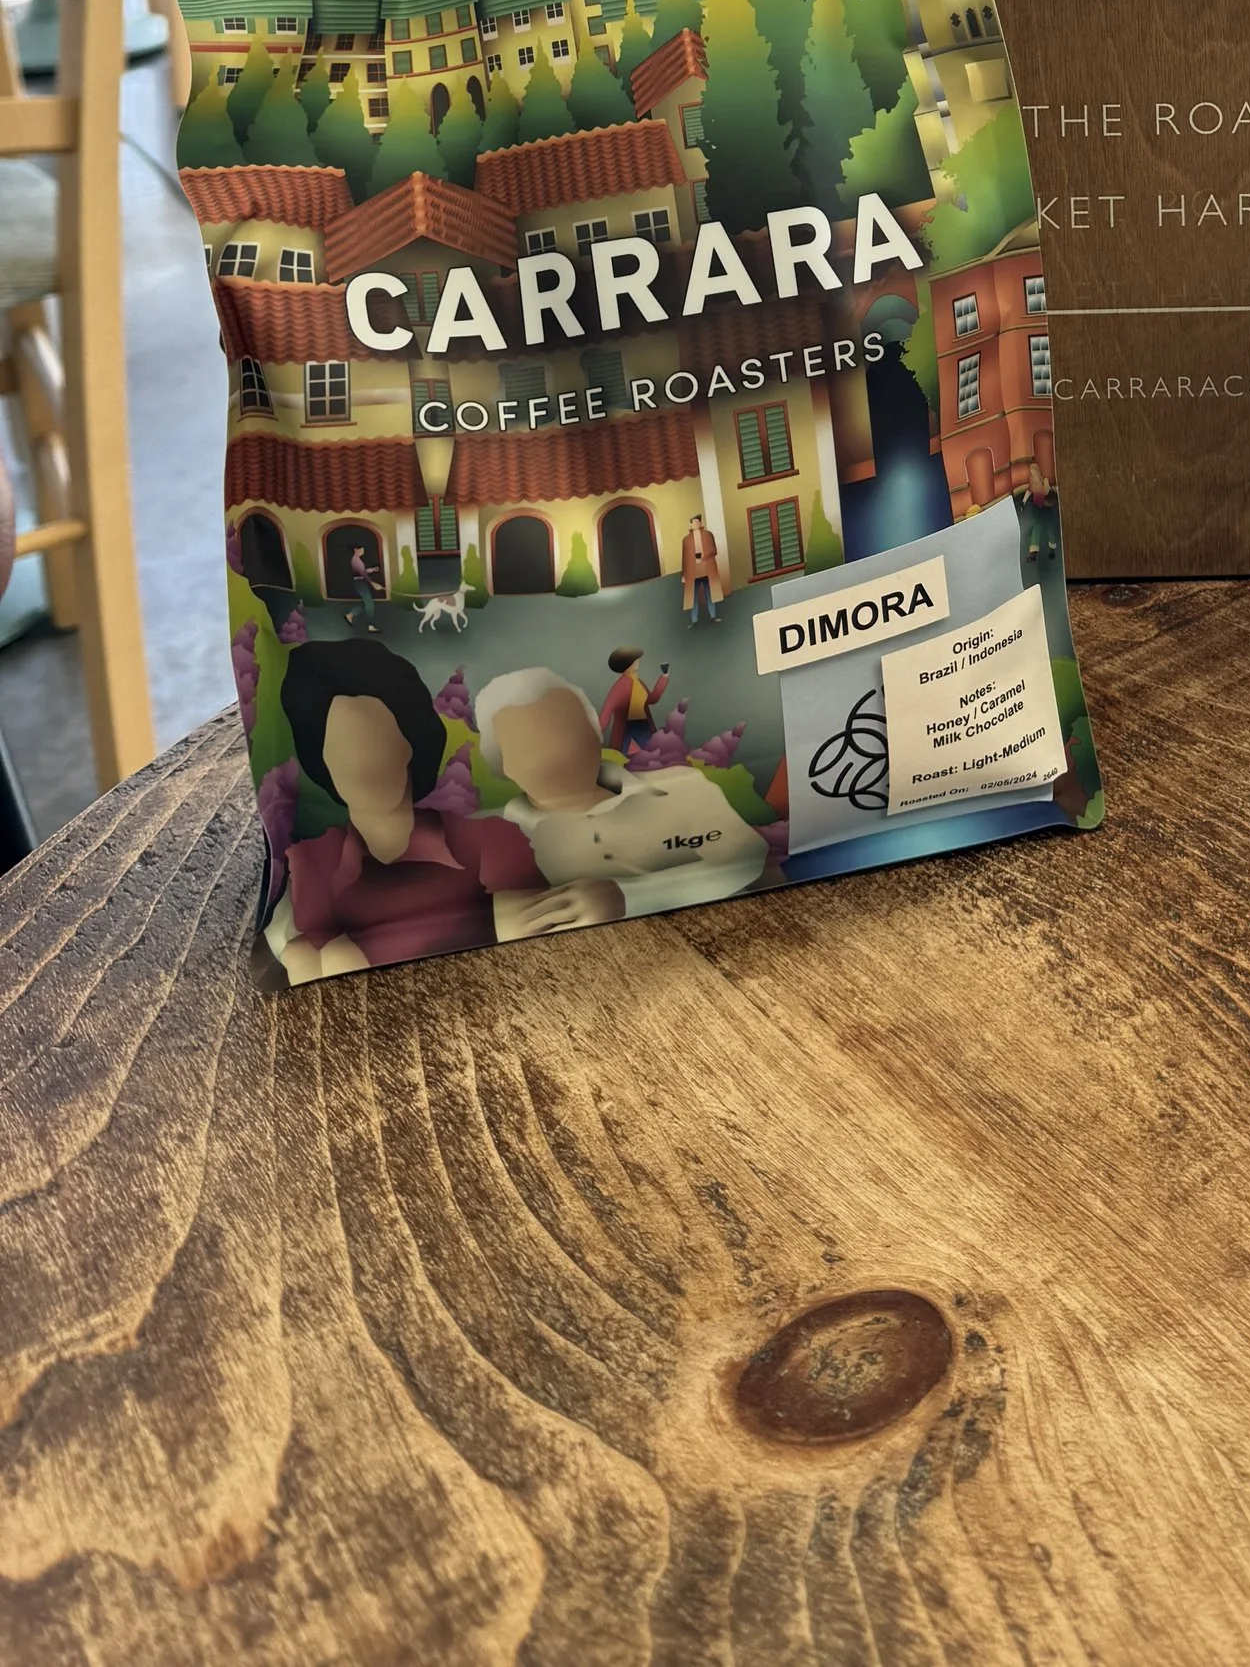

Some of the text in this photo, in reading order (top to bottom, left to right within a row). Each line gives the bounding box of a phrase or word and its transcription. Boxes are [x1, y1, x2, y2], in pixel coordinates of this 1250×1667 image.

[1022, 104, 1122, 138] THE
[343, 191, 925, 355] CARRARA
[417, 331, 886, 433] COFFEE ROASTERS
[778, 582, 935, 655] DIMORA
[952, 628, 994, 655] Origin:
[919, 660, 958, 685] Brazil
[968, 628, 1024, 666] Indonesia
[926, 713, 971, 736] Honey
[980, 679, 1026, 715] Caramel
[959, 681, 997, 709] Notes:
[932, 700, 1025, 749] Milk Chocolate
[911, 725, 1046, 785] Roast: Light-Medium
[900, 790, 947, 807] Roasted
[949, 786, 969, 795] On:
